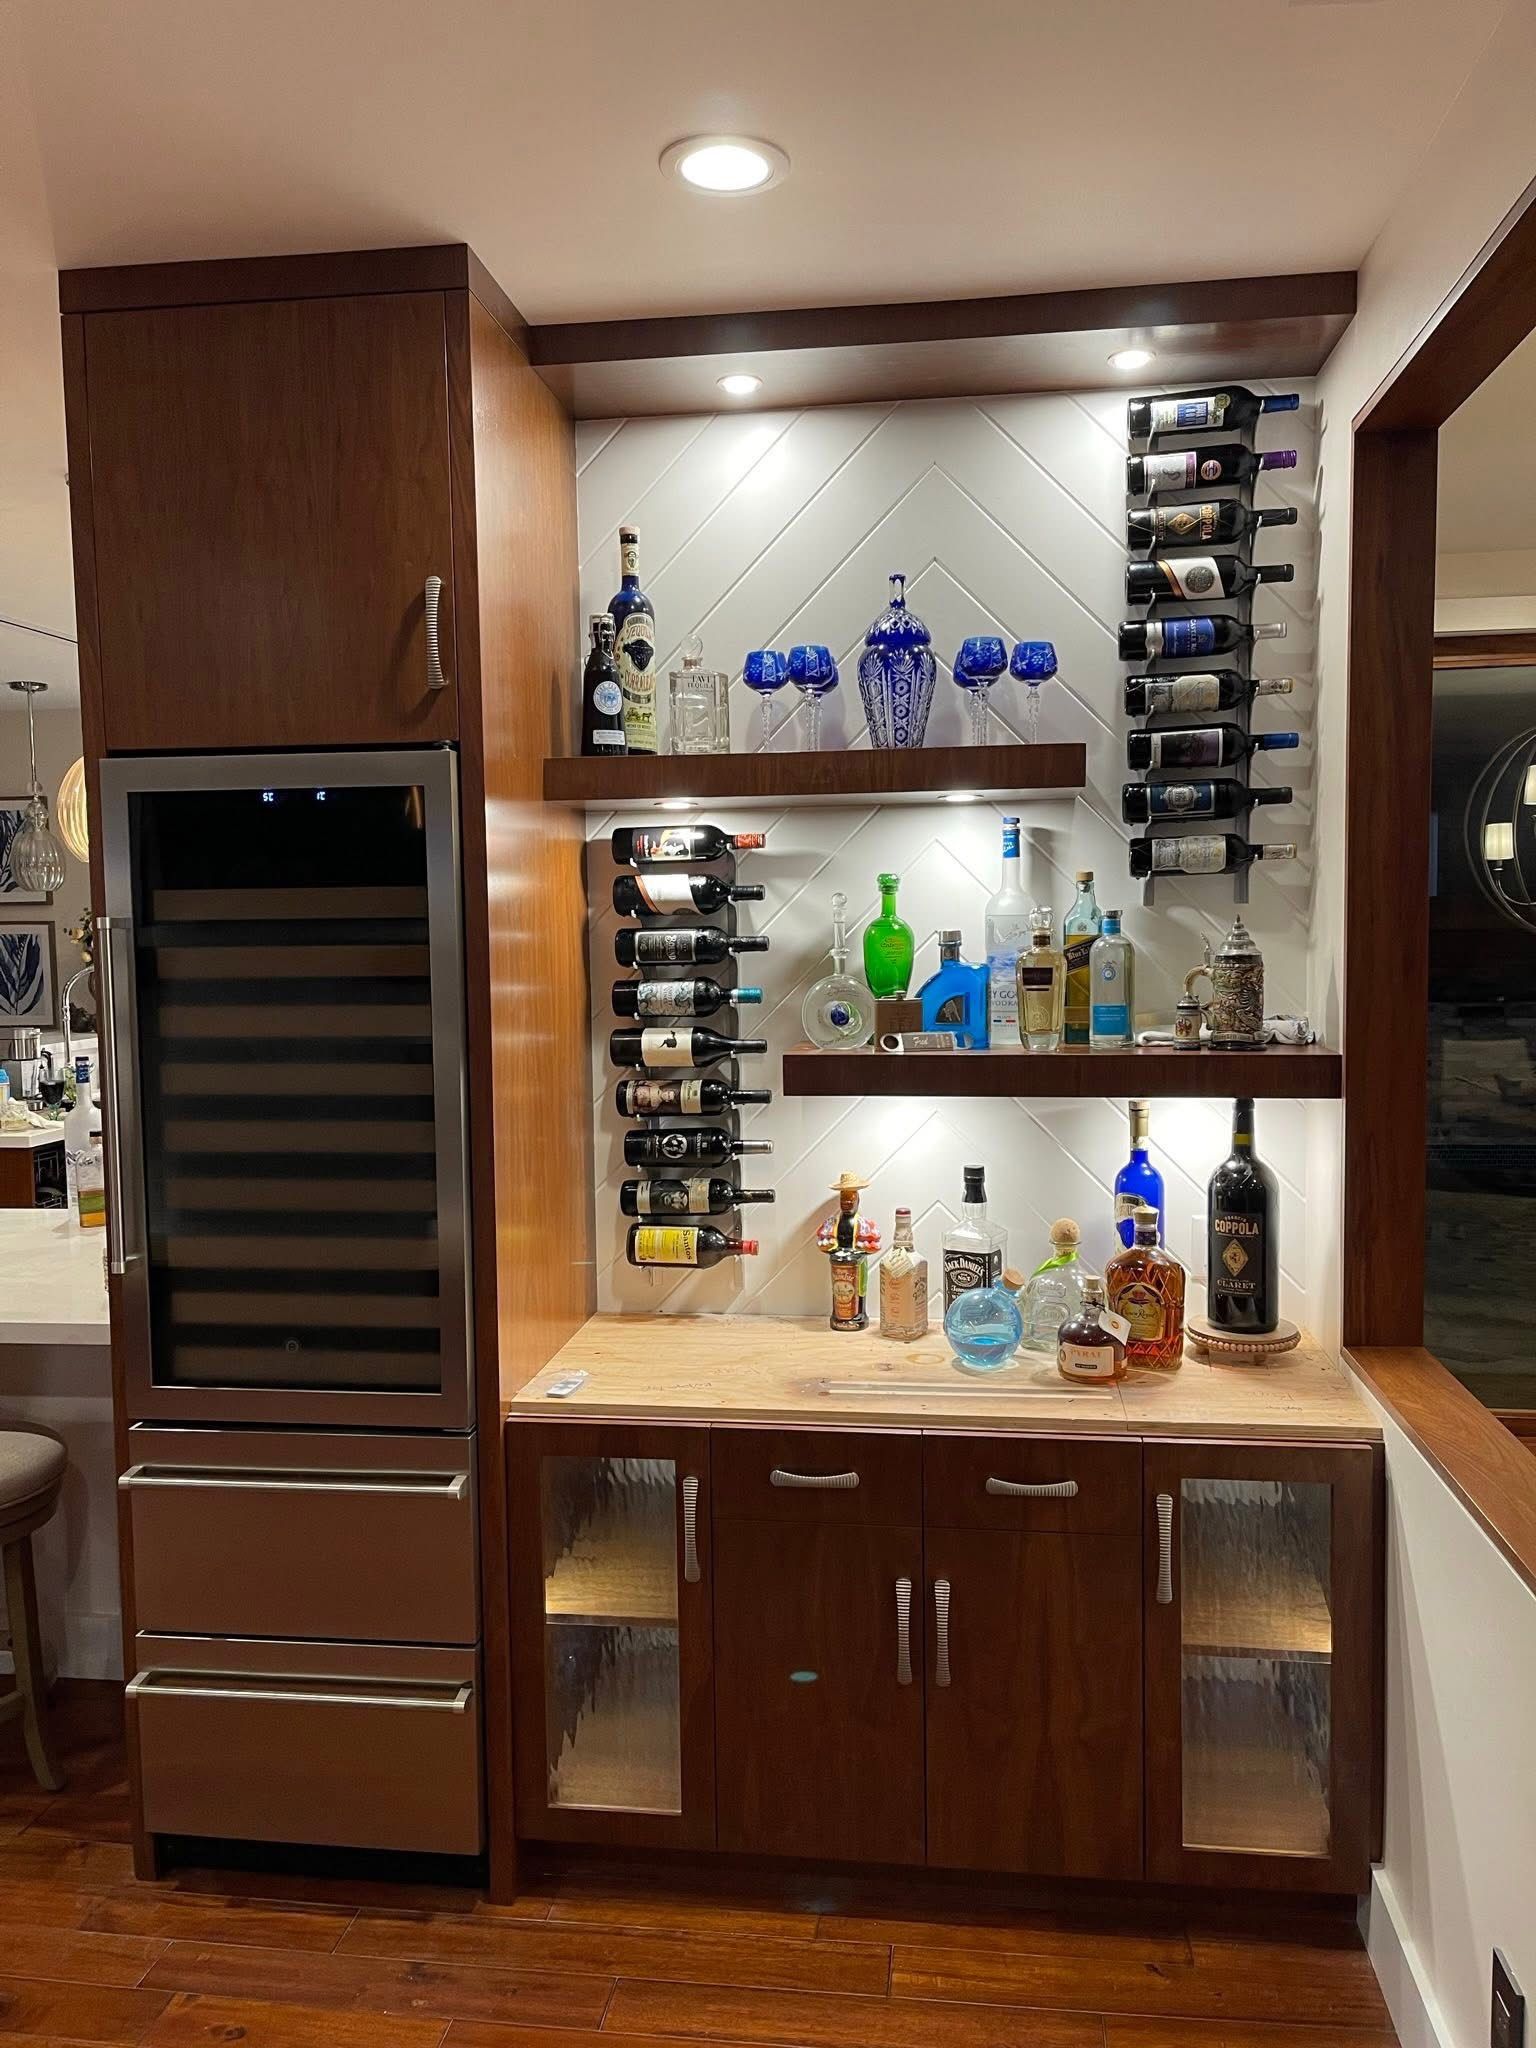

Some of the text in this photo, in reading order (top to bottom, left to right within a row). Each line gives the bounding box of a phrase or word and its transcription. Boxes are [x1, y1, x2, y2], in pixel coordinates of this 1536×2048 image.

[1201, 504, 1213, 540] COPPOLA
[1215, 1218, 1260, 1235] COPPOLA
[682, 1230, 692, 1260] Santos
[944, 1257, 986, 1278] JACK DANIEL'S
[1216, 1279, 1257, 1290] CLARET
